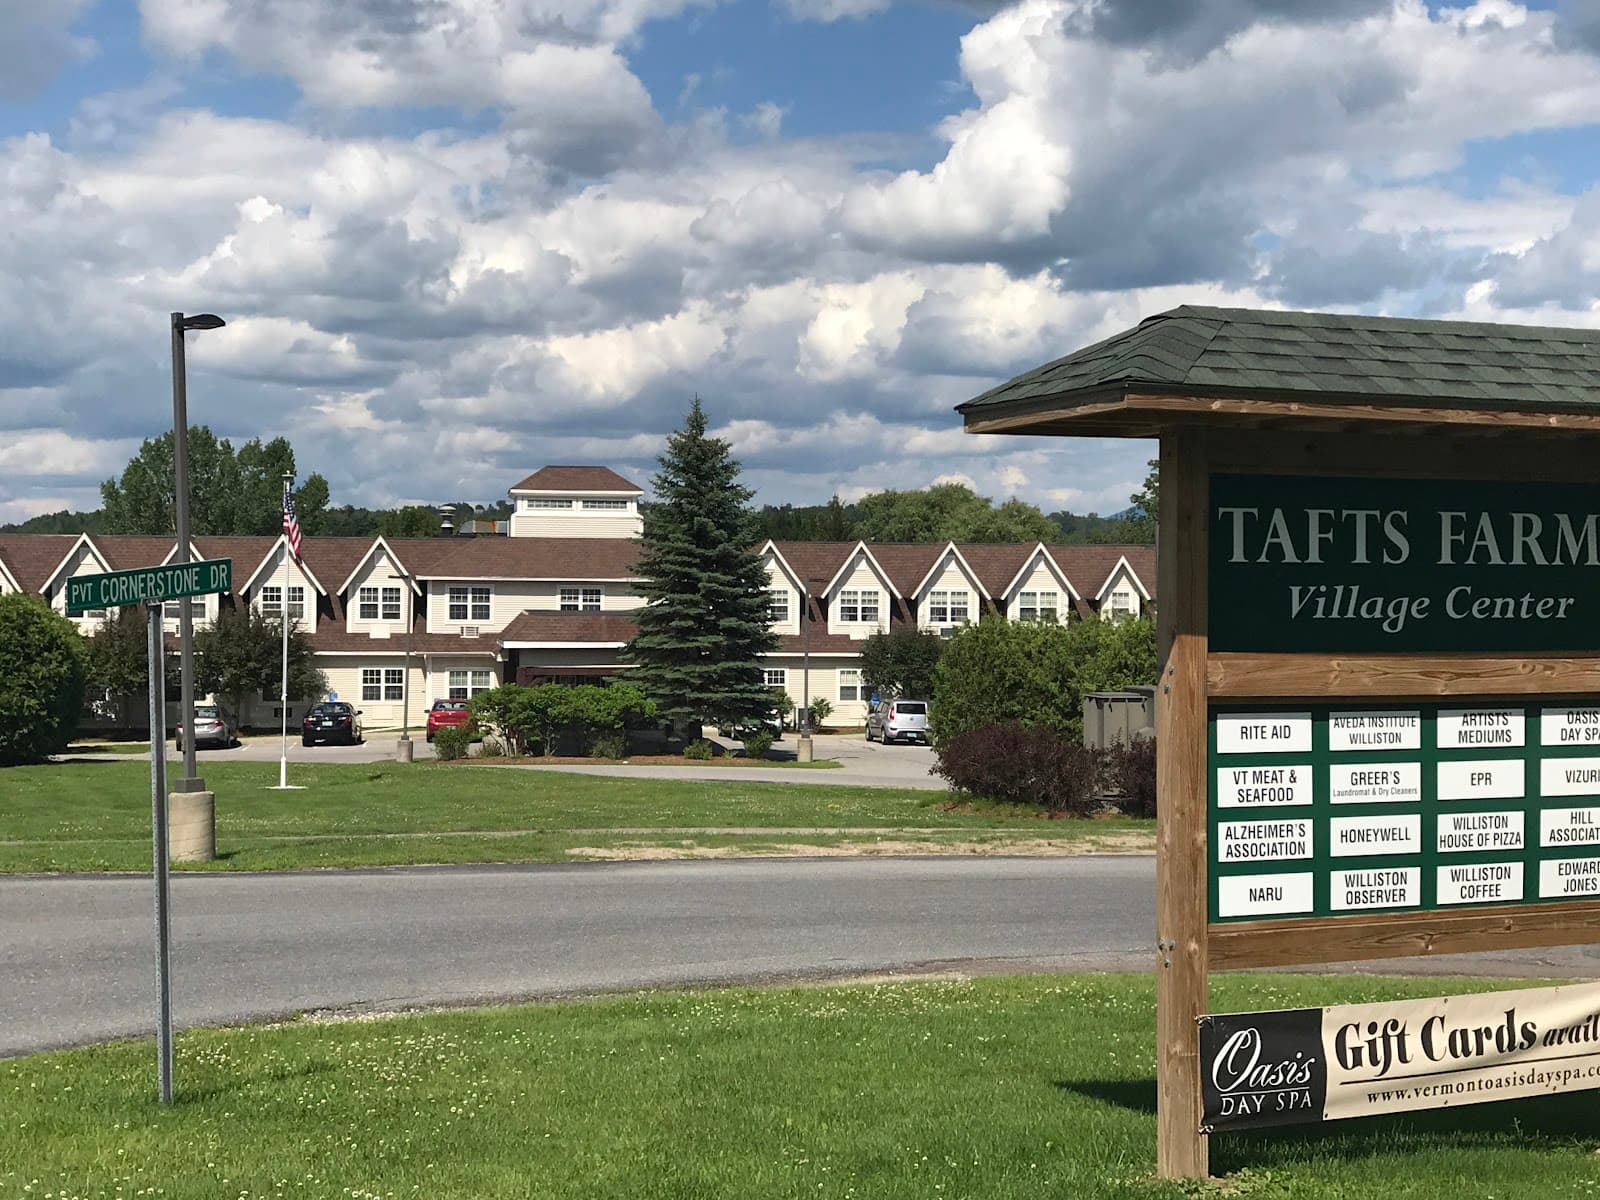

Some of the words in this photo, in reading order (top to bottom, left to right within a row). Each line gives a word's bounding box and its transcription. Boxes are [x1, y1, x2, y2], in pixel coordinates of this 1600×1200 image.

[1218, 507, 1410, 565] TAFTS
[1436, 511, 1600, 566] FARM
[72, 582, 93, 603] PVT
[100, 567, 200, 604] CORNERSTONE
[210, 564, 228, 589] DR
[1288, 584, 1431, 633] Village
[1445, 585, 1575, 620] Center
[1333, 717, 1366, 729] AVEDA
[1367, 716, 1416, 728] INSTITUTE
[1567, 711, 1599, 725] OASIS
[1240, 725, 1267, 740] RITE
[1271, 725, 1291, 739] AID
[1349, 732, 1402, 745] WILLISTON
[1458, 729, 1512, 744] MEDIUMS
[1560, 728, 1581, 741] DAY
[1585, 727, 1600, 741] SP
[1233, 770, 1248, 785] VT
[1252, 770, 1285, 784] MEAT
[1289, 769, 1297, 784] &
[1350, 771, 1400, 786] GREER'S
[1470, 772, 1492, 786] EPR
[1237, 788, 1294, 803] SEAFOOD
[1333, 788, 1370, 797] Laundromat
[1378, 788, 1389, 797] Dry
[1390, 787, 1418, 795] Cleaners
[1453, 815, 1508, 831] WILLISTON
[1570, 811, 1593, 825] HILL
[1225, 823, 1306, 840] ALZHEIMER'S
[1340, 827, 1411, 843] HONEYWELL
[1549, 827, 1600, 843] ASSOCIAT
[1439, 834, 1474, 849] HOUSE
[1477, 833, 1490, 847] OF
[1493, 832, 1522, 846] PIZZA
[1225, 841, 1306, 859] ASSOCIATION
[1345, 871, 1408, 888] WILLISTON
[1450, 866, 1511, 882] WILLISTON
[1460, 883, 1502, 899] COFFEE
[1563, 877, 1598, 893] JONES
[1249, 887, 1283, 902] NARU
[1346, 888, 1406, 905] OBSERVER
[1334, 1018, 1414, 1077] Gift
[1420, 1007, 1538, 1063] Cards
[1542, 1014, 1600, 1047] avail
[1211, 1027, 1315, 1093] Oasis
[1220, 1094, 1266, 1116] DAY
[1276, 1090, 1313, 1112] SPA
